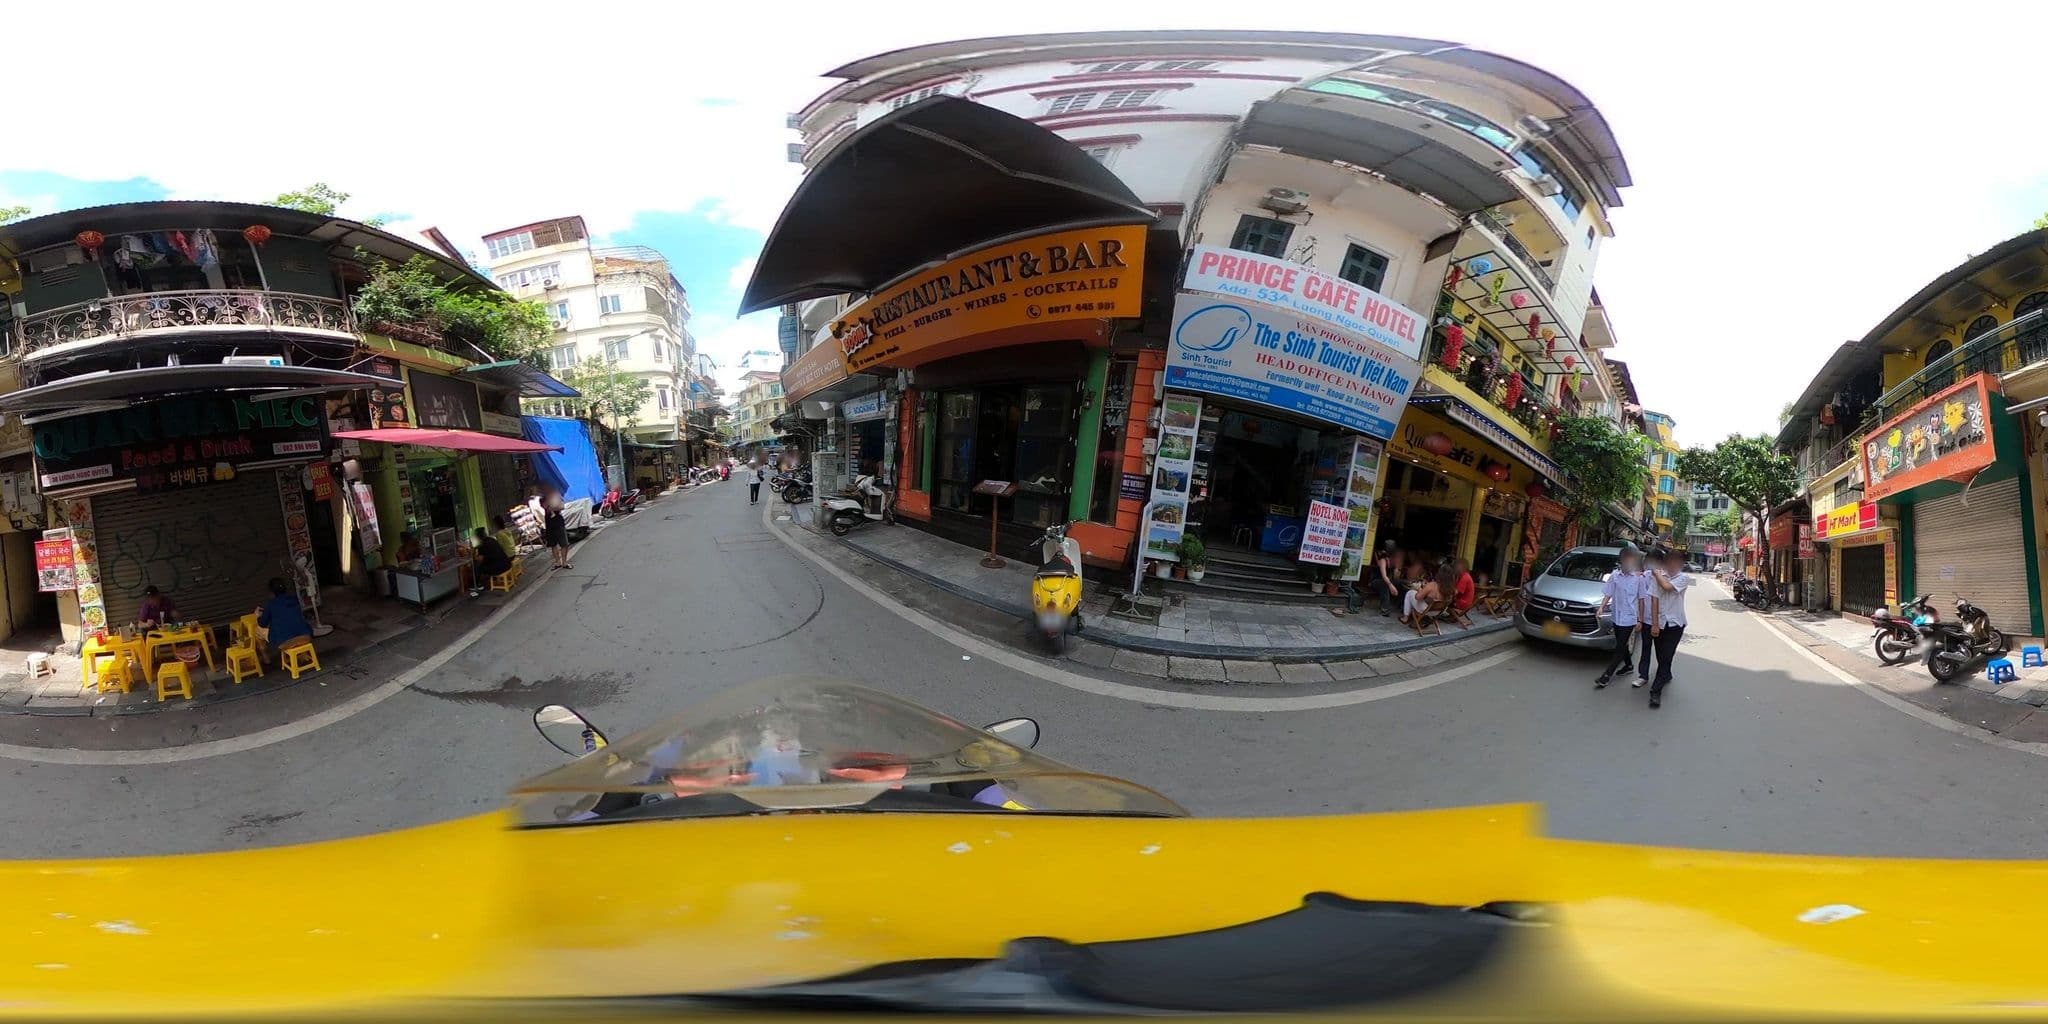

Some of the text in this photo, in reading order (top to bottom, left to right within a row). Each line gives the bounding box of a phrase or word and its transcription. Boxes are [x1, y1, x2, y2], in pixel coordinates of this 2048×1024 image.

[872, 239, 1129, 329] RESTAURANT & BAR
[1198, 252, 1417, 343] PRINCE CAFE HOTEL
[884, 326, 906, 340] PIZZA
[914, 307, 952, 328] BURGER
[964, 293, 1007, 311] WINES
[1024, 277, 1119, 298] COCKTAILS
[1217, 283, 1251, 296] Add:
[1293, 300, 1333, 322] Luong
[1336, 314, 1366, 333] Ngoc
[1368, 328, 1401, 348] Quyen
[1182, 352, 1232, 368] Sinh Tourist
[1254, 323, 1410, 397] The Sinh Tourist Việt Nam
[1255, 353, 1395, 406] HEAD OFFICE IN HANOI
[1311, 503, 1331, 519] HOTEL
[1333, 509, 1349, 522] ROOM
[1838, 511, 1857, 529] Mart
[1302, 552, 1313, 560] SIM
[1313, 554, 1330, 562] CARD
[1308, 534, 1341, 546] MONEY EXCHANGE
[1332, 548, 1342, 556] RENT
